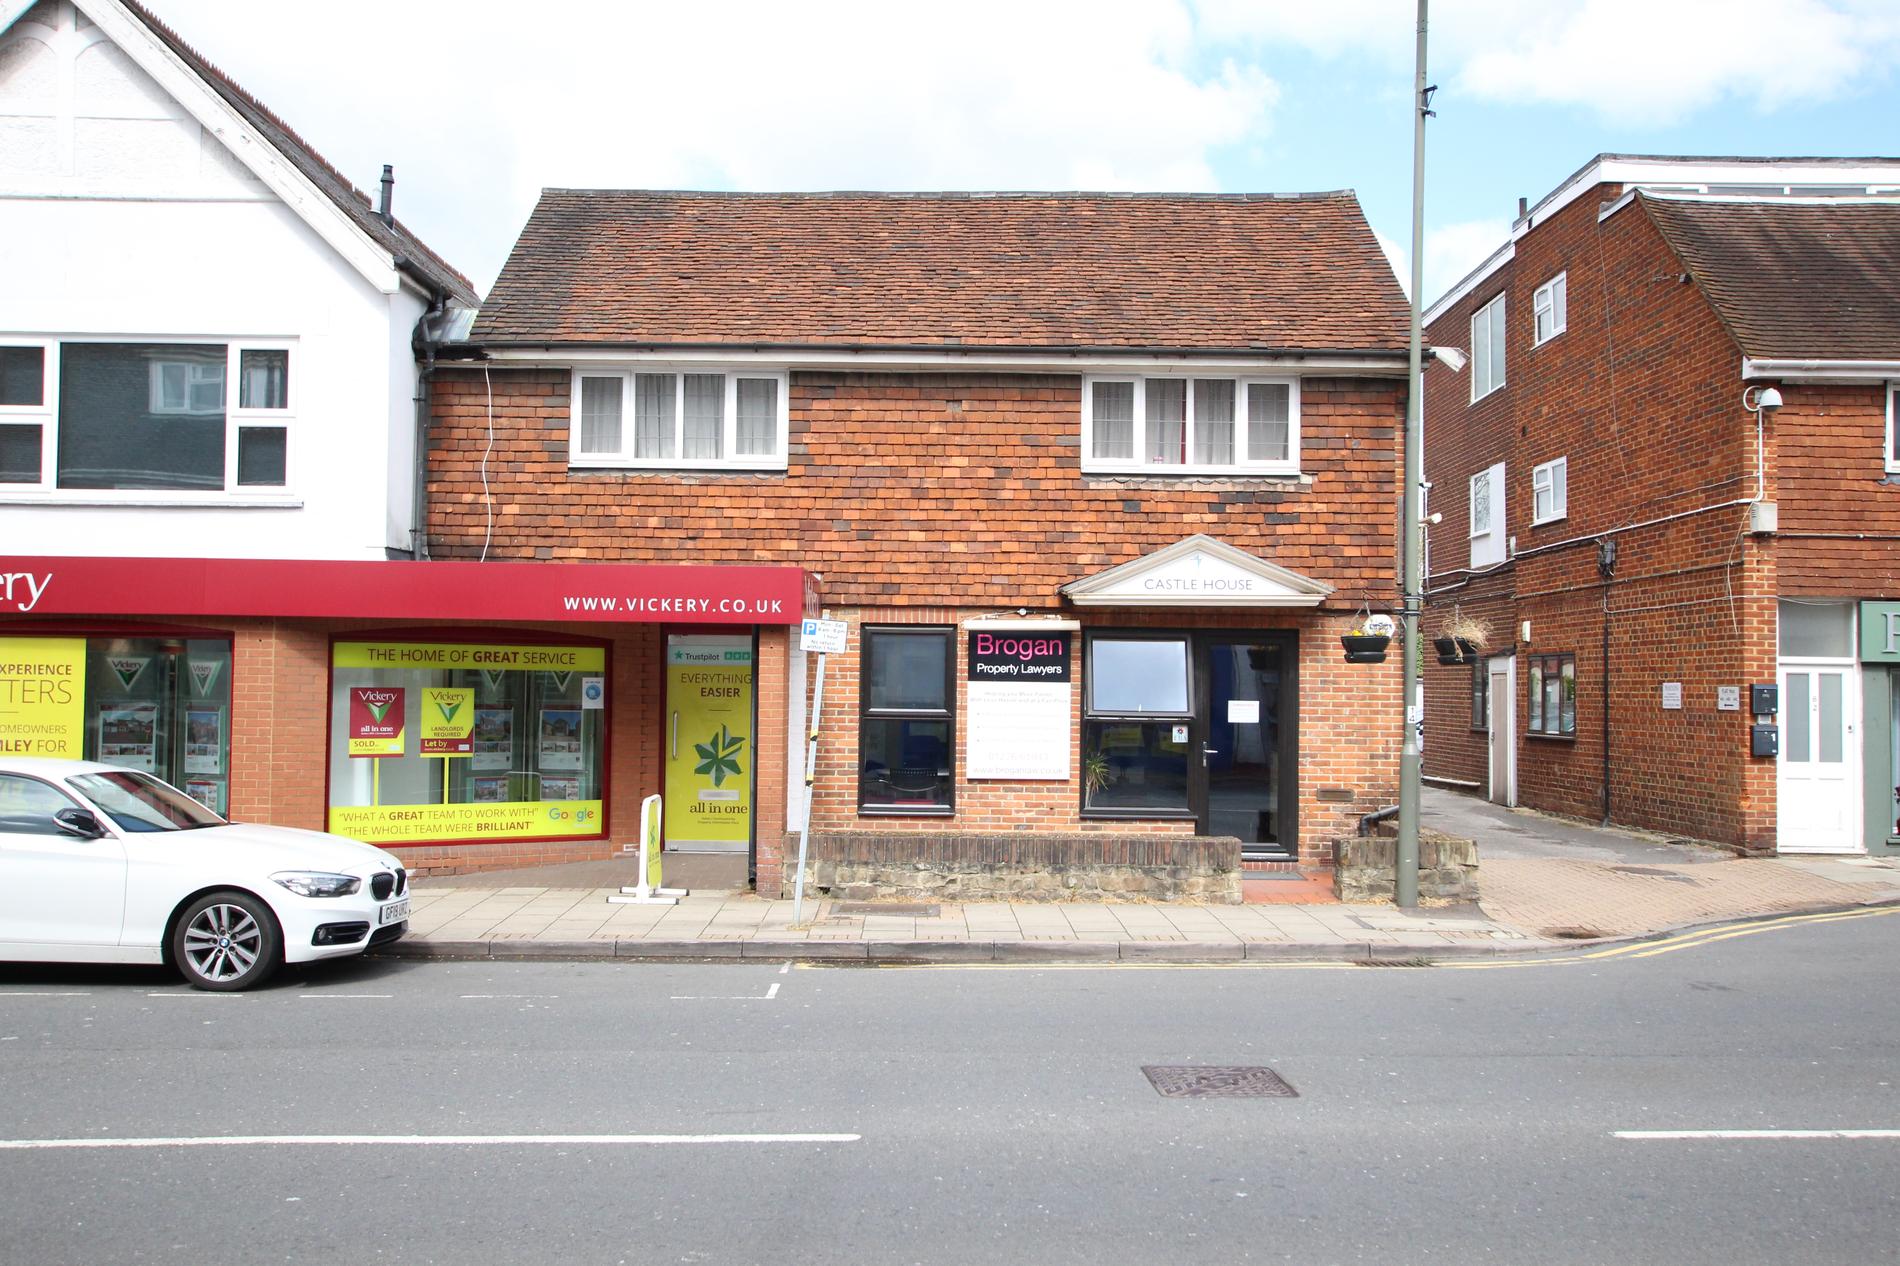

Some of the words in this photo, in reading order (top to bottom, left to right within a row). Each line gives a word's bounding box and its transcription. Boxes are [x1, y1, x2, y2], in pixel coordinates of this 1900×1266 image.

[1144, 578, 1198, 590] CASTLE
[1204, 578, 1253, 591] HOUSE
[563, 596, 783, 613] WWW.VICKERY.CO.UK
[806, 623, 816, 634] P
[977, 633, 1063, 661] Brogan
[368, 648, 396, 661] THE
[400, 649, 445, 662] HOME
[449, 650, 469, 662] OF
[472, 650, 520, 664] GREAT
[523, 651, 576, 665] SERVICE
[685, 652, 720, 661] Trustpilot
[977, 663, 1019, 676] Property
[1021, 663, 1063, 676] Lawyers
[680, 673, 752, 685] EVERYTHING
[358, 690, 398, 703] Vickery
[430, 691, 466, 703] Vickery
[700, 687, 741, 698] EASIER
[1770, 733, 1777, 742] 1
[37, 740, 67, 753] FOR
[354, 740, 375, 748] SOLD
[438, 740, 448, 748] by
[689, 802, 705, 814] all
[708, 802, 721, 814] in
[724, 805, 748, 814] one
[378, 811, 386, 821] A
[388, 810, 424, 821] GREAT
[427, 809, 457, 820] TEAM
[458, 809, 473, 819] TO
[475, 808, 507, 818] WORK
[371, 825, 410, 835] WHOLE
[413, 824, 443, 834] TEAM
[445, 823, 474, 833] WERE
